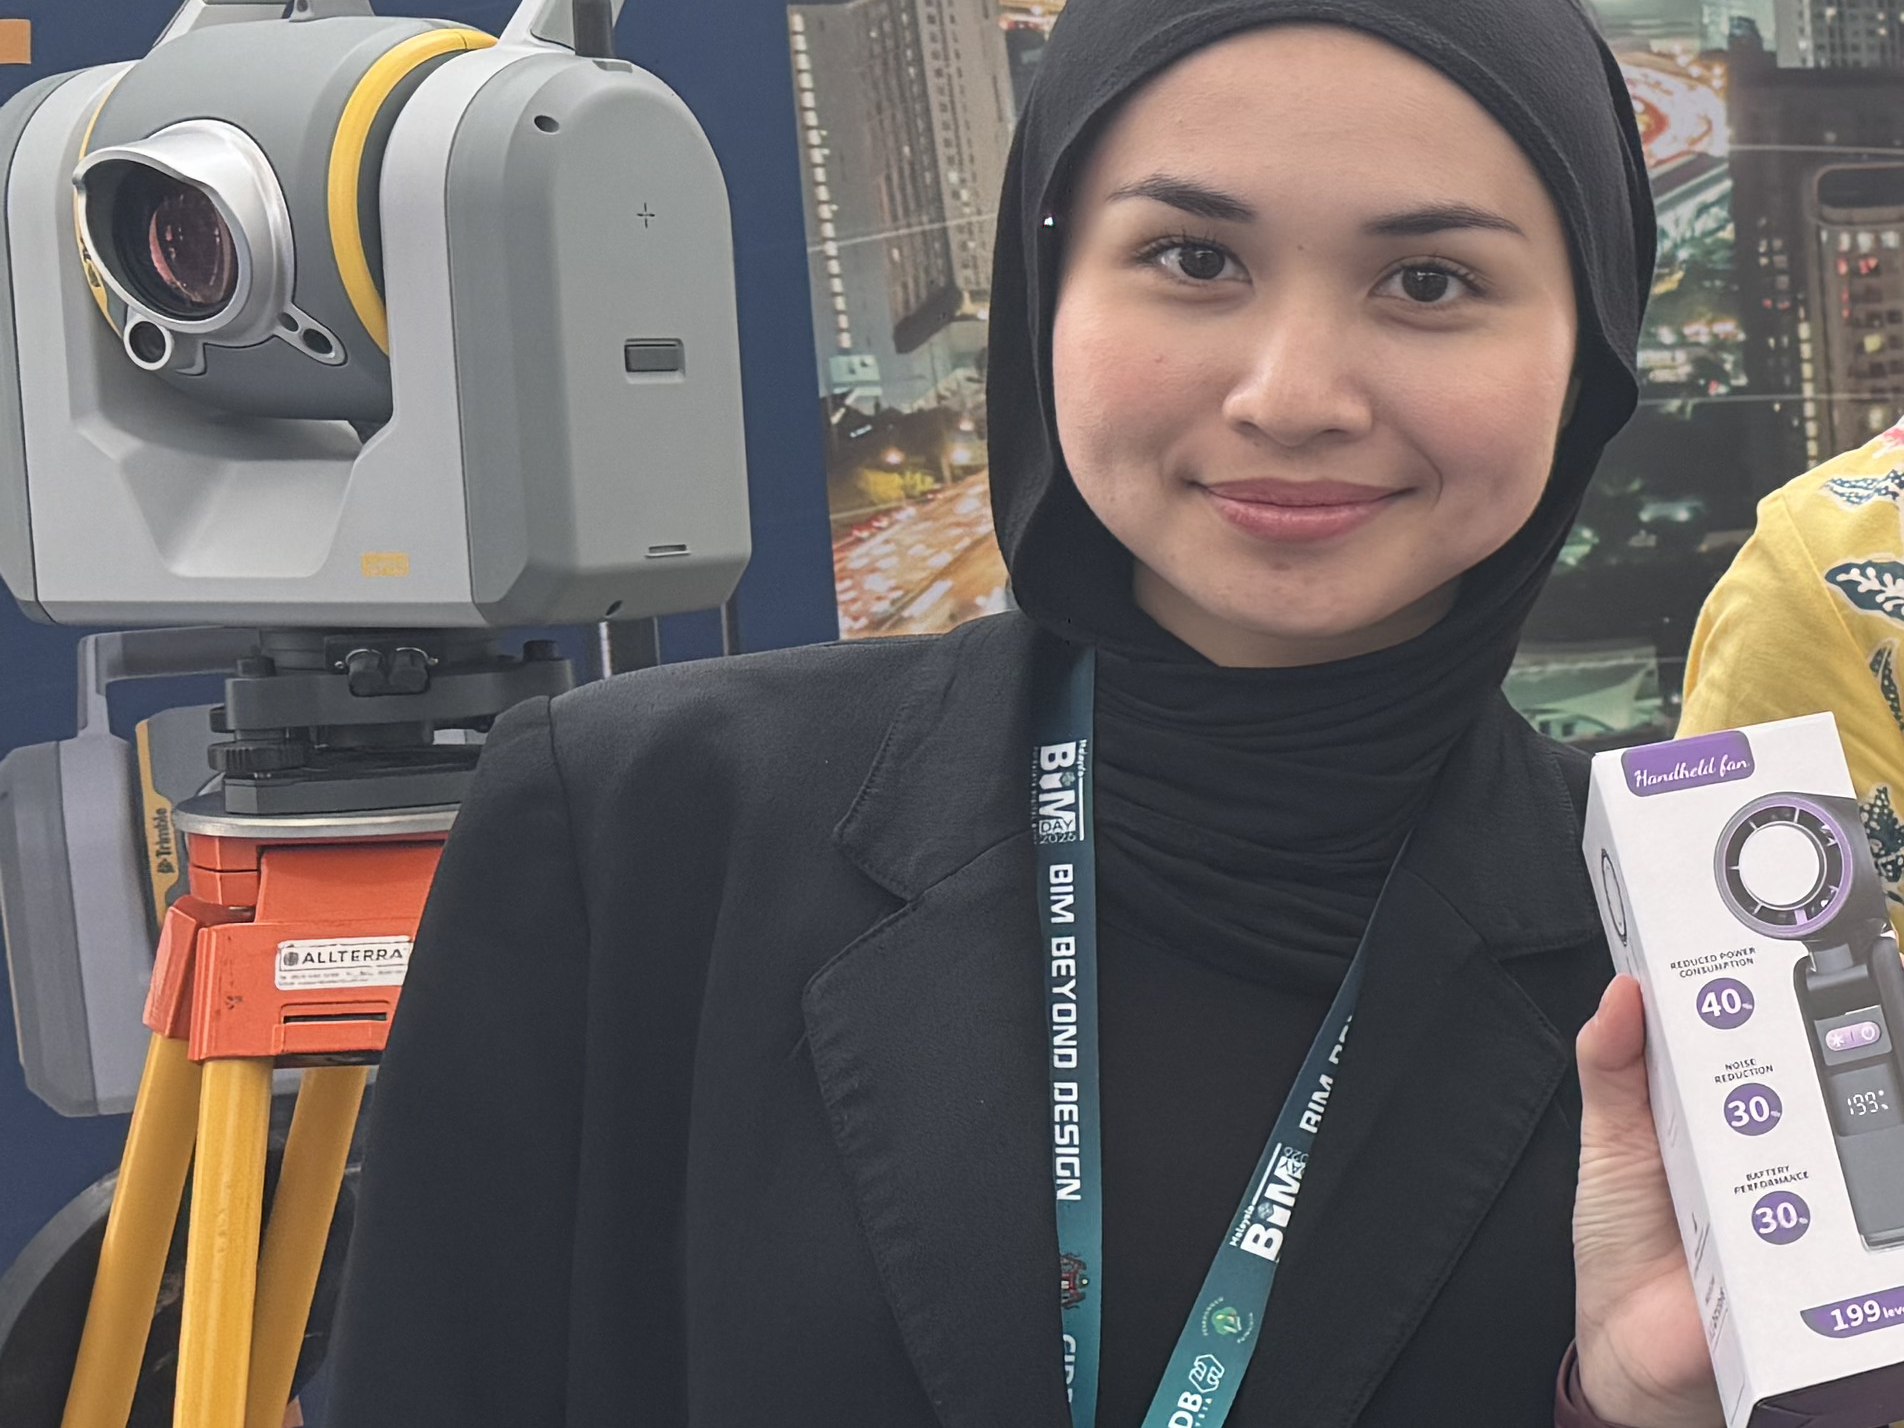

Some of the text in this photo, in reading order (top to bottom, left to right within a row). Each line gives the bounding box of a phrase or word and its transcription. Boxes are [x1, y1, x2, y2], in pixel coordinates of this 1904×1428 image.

[1634, 754, 1748, 788] Handheld fan
[153, 807, 171, 857] Trimble
[1039, 819, 1076, 836] DAY
[301, 949, 403, 964] ALLTERRA
[1670, 947, 1756, 970] REDUCED POWER
[1050, 864, 1081, 1202] BIM BEYOND DESIGN
[1714, 1065, 1774, 1084] REDUCTION
[1725, 1058, 1756, 1071] NOISE
[1746, 1165, 1790, 1182] BATTERY
[1229, 1204, 1255, 1247] Malaysia
[1830, 1299, 1882, 1332] 199
[1062, 1333, 1078, 1403] CI
